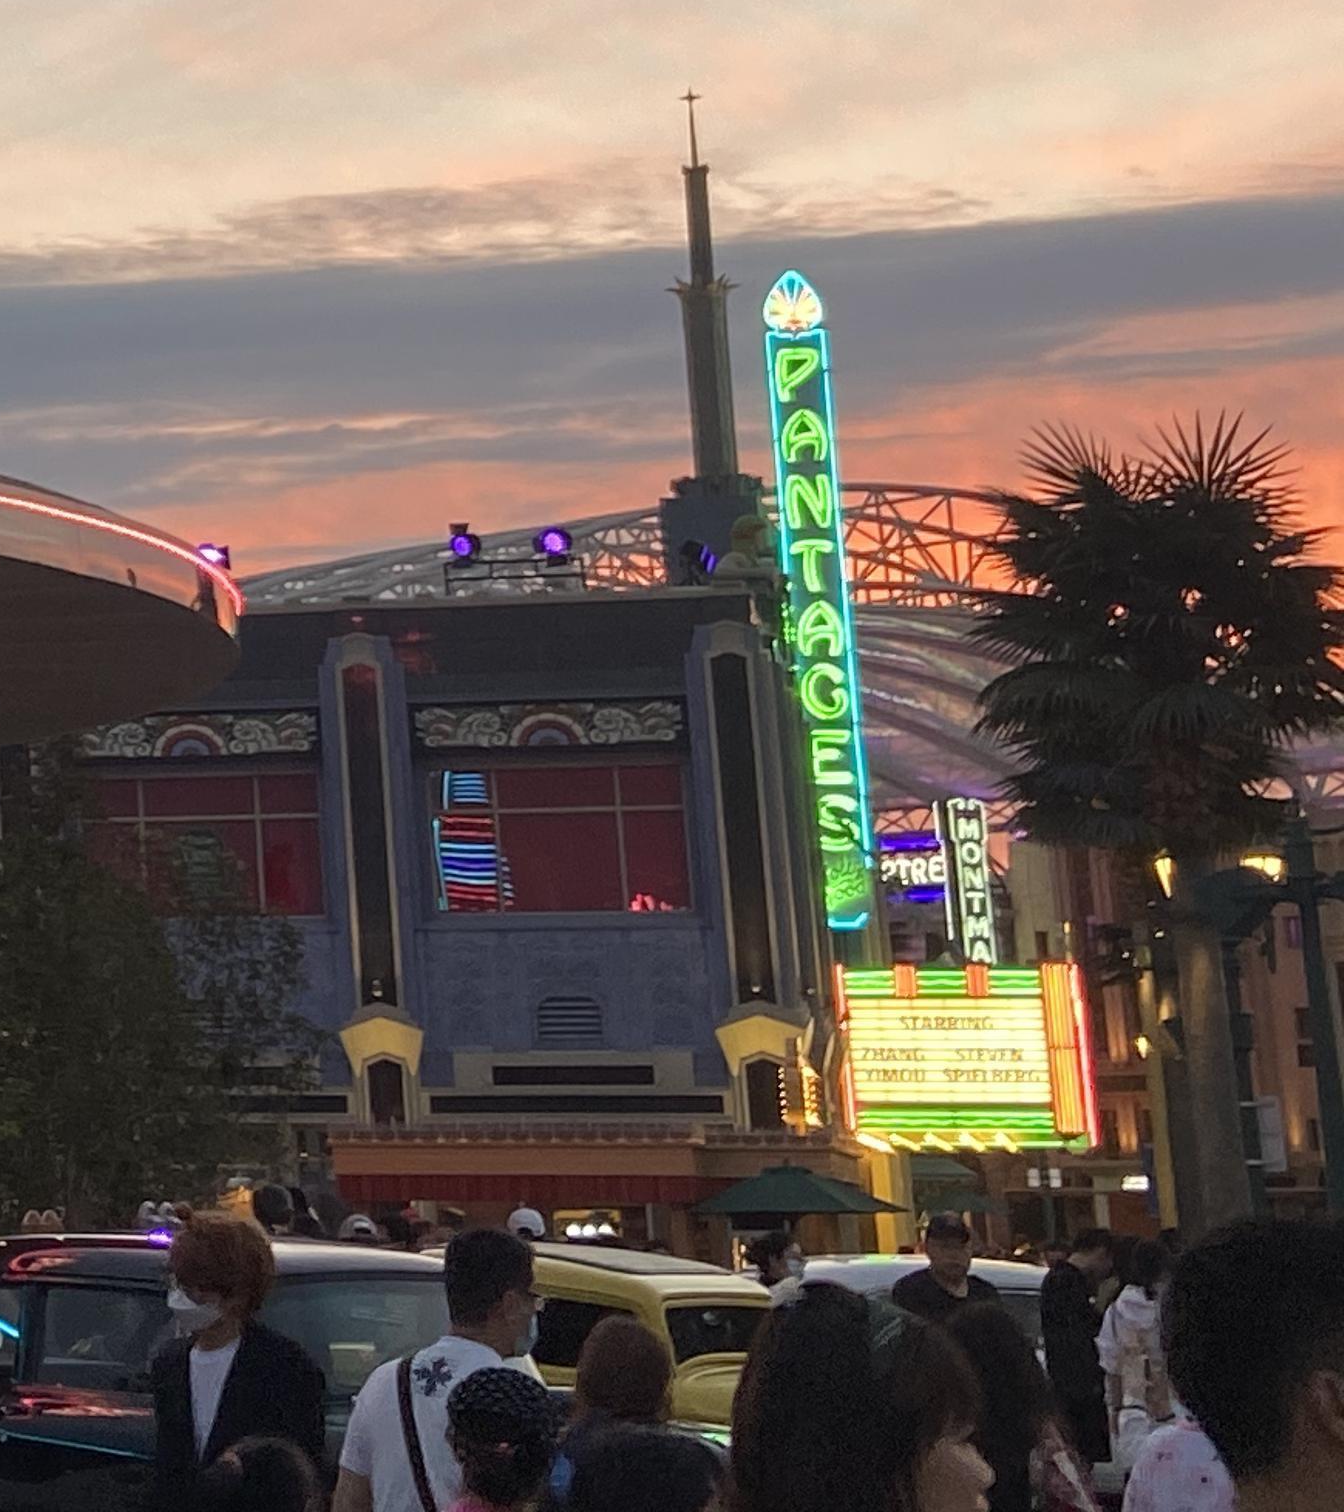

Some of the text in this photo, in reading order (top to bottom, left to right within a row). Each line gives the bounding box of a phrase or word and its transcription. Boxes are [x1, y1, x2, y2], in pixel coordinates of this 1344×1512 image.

[774, 347, 861, 853] PANTAGES
[898, 1015, 994, 1031] STARRING
[860, 1047, 1025, 1062] ZHANG STEVEN
[864, 1067, 1041, 1083] YIMOU SPIELBERG
